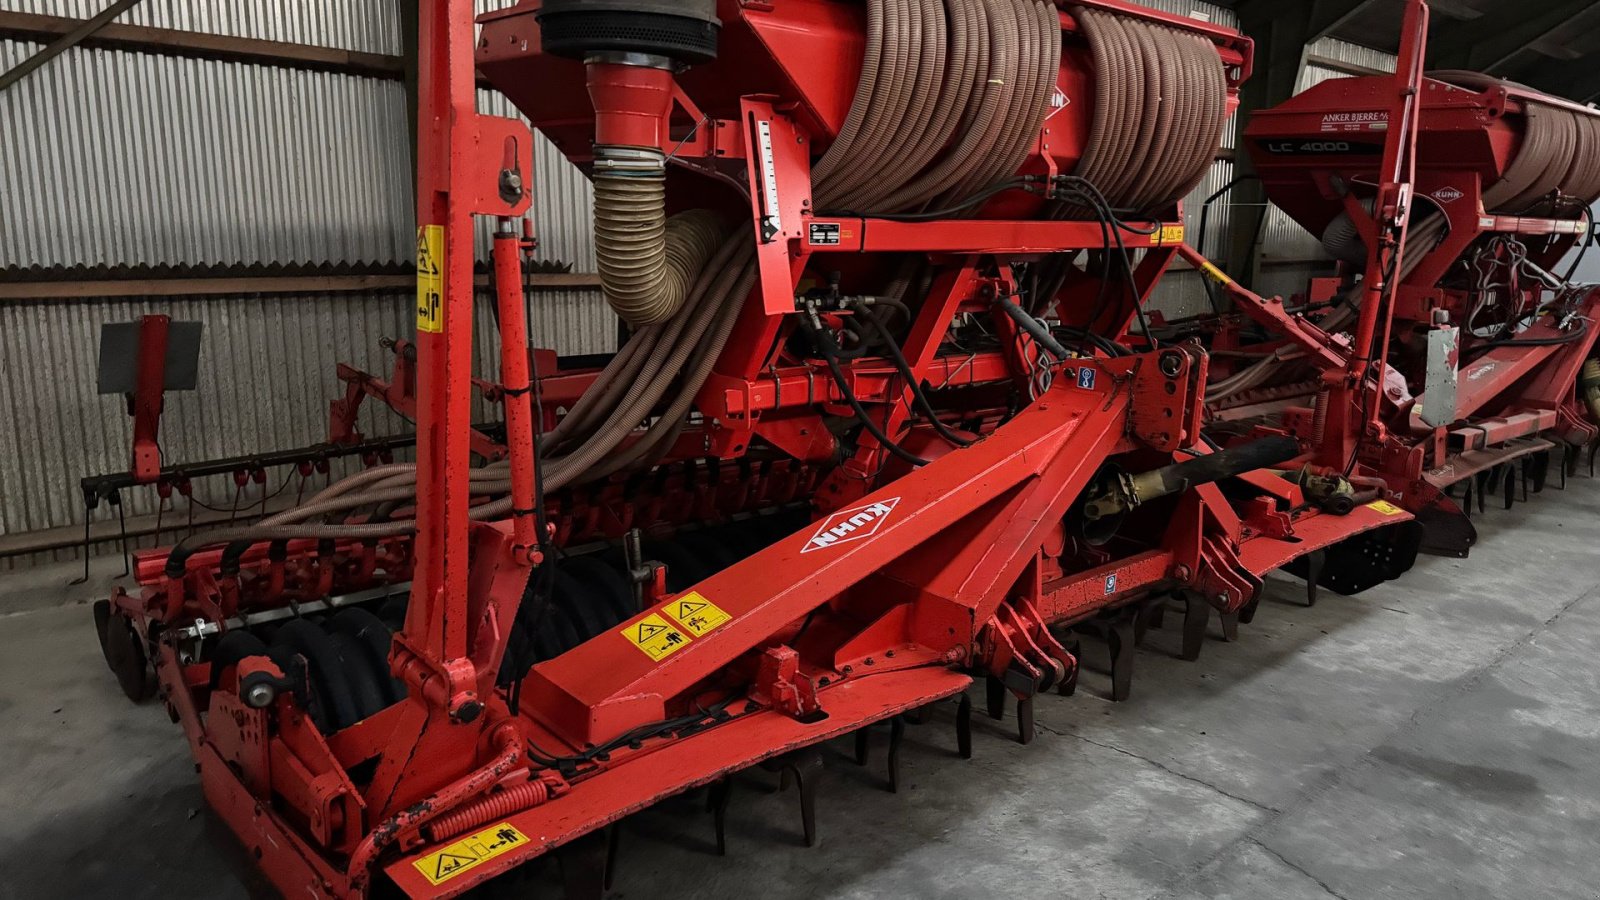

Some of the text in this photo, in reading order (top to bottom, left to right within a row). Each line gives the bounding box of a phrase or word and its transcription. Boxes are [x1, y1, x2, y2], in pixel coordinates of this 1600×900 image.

[1322, 113, 1350, 122] ANKER
[1351, 112, 1379, 122] BJERRE
[1268, 142, 1350, 152] LC 4000
[810, 502, 892, 548] KUHN
